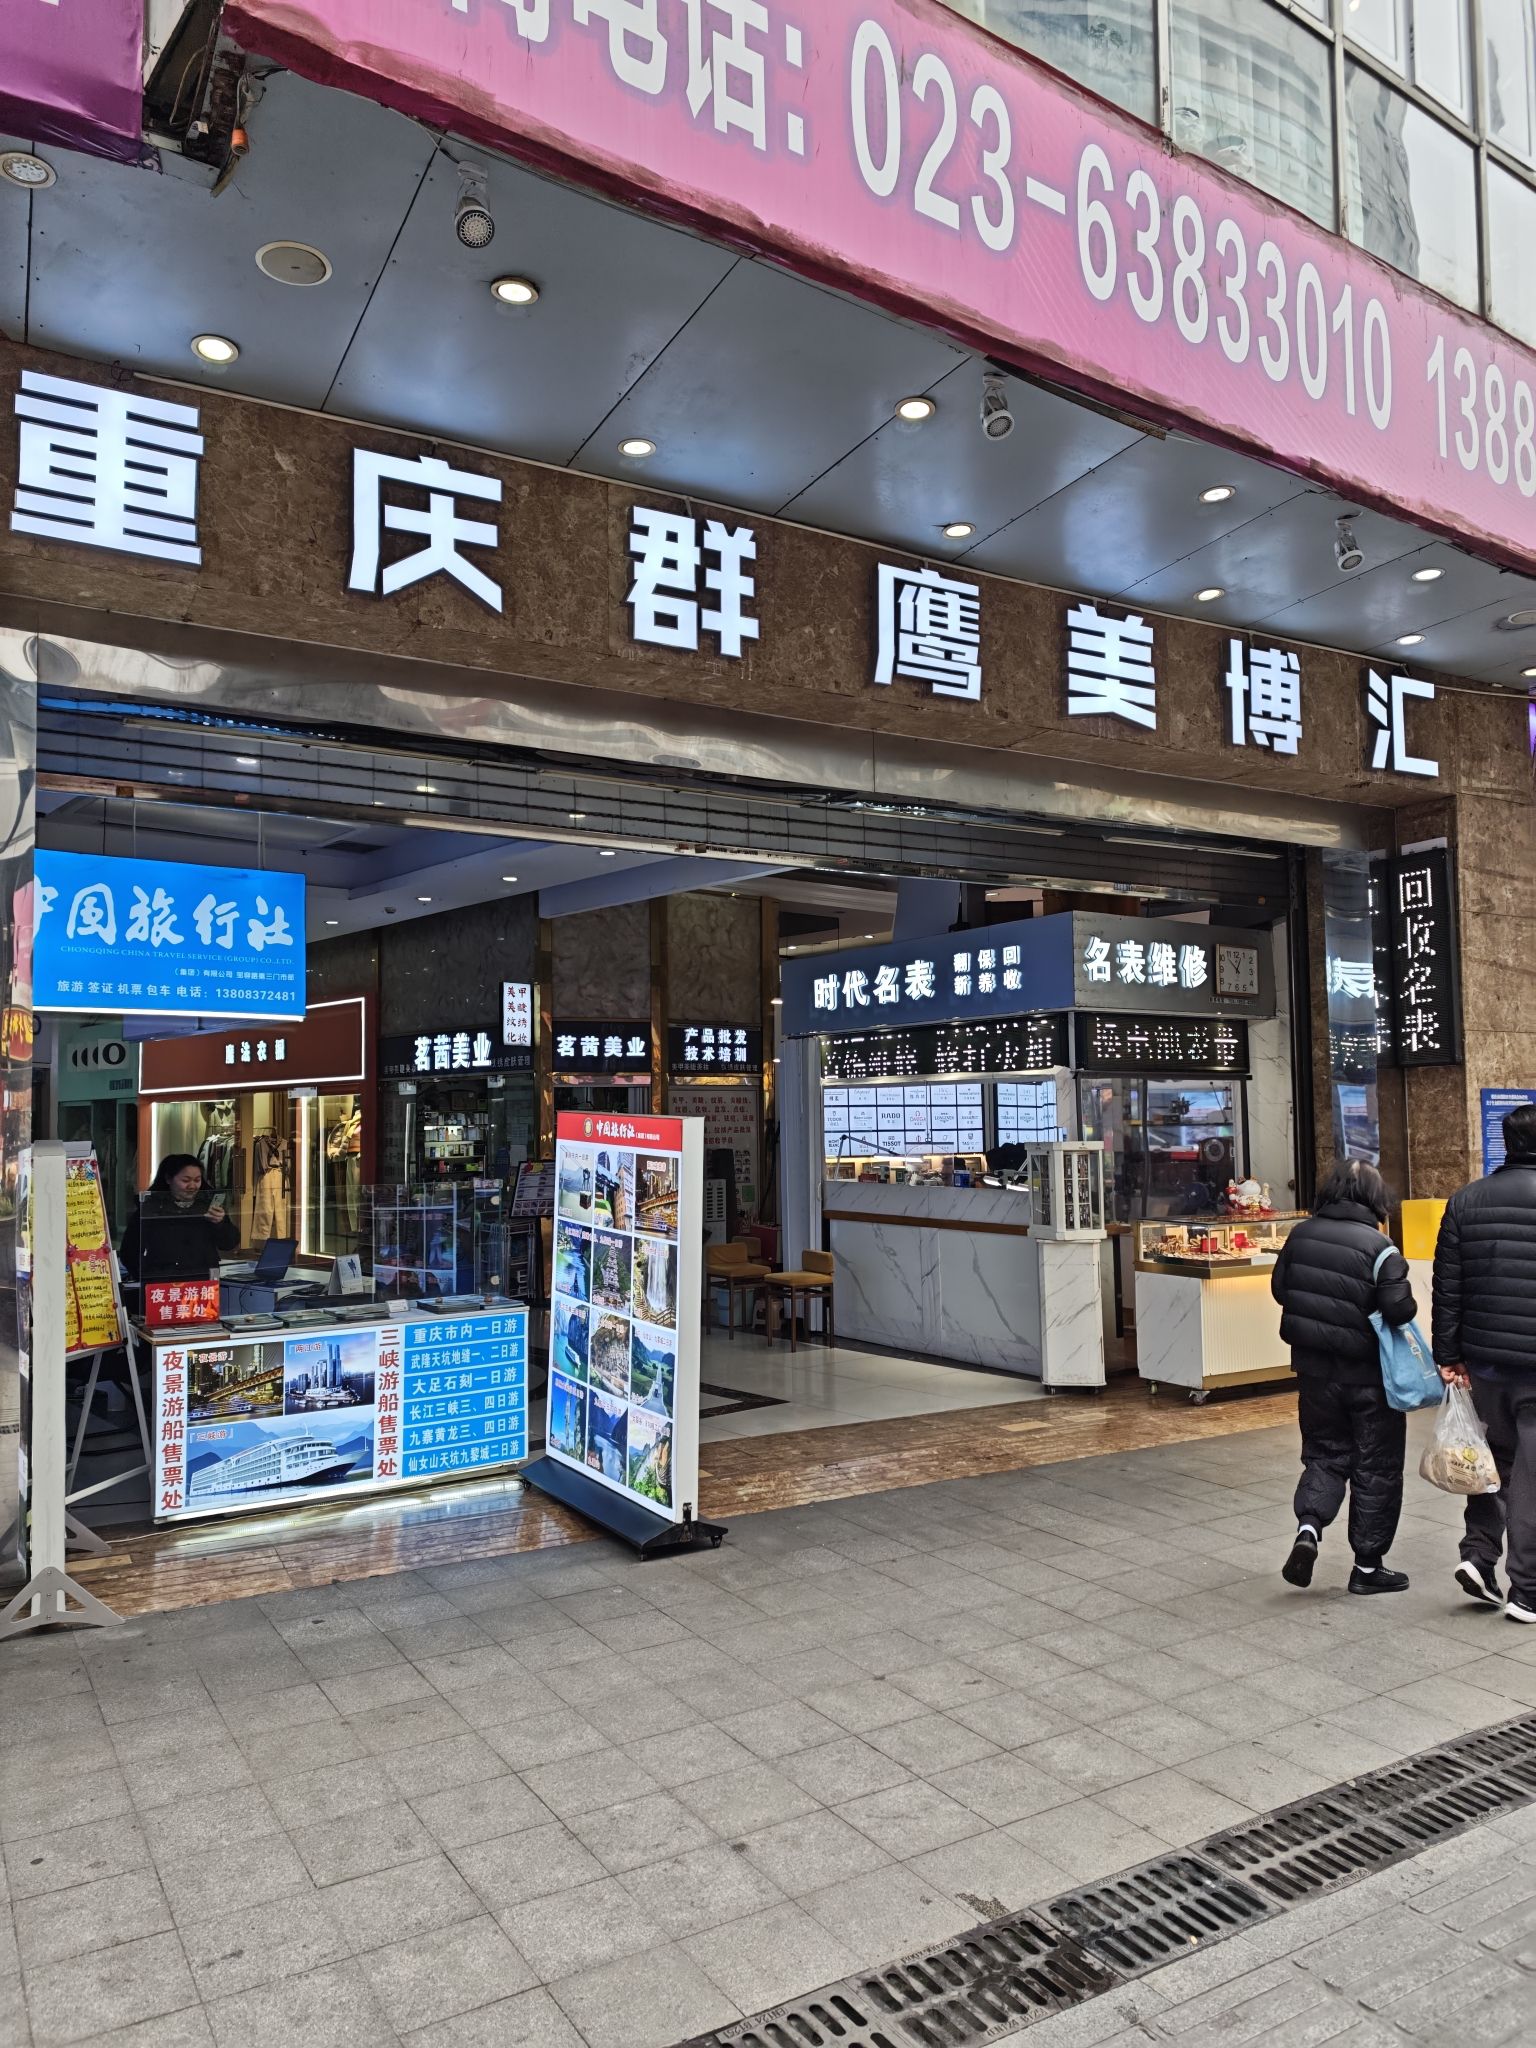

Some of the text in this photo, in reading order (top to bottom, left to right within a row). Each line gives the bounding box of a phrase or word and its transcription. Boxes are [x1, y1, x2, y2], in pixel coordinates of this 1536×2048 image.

[850, 19, 1393, 431] 023-63833010
[9, 369, 1440, 778] 重庆群鹰美博汇
[60, 945, 120, 956] CHONGQING
[120, 949, 150, 957] CHINA
[152, 951, 186, 959] TRAVEL
[187, 953, 222, 961] SERVICE
[1083, 936, 1209, 989] 名表维修
[1396, 867, 1441, 1053] 回收名表
[57, 980, 84, 993] 旅游
[88, 981, 113, 994] 签证
[117, 983, 143, 995] 机票
[146, 984, 171, 996] 包车
[215, 988, 296, 1002] 13808372481
[813, 959, 936, 1011] 时代名表
[683, 1027, 748, 1045] 产品批发
[684, 1045, 748, 1063] 技术培训
[150, 1286, 216, 1304] 夜景游船
[158, 1304, 209, 1321] 售票处
[412, 1318, 518, 1344] 重庆市内一日游
[410, 1342, 519, 1370] 武隆天坑地缝一、二日游
[411, 1367, 518, 1396] 大足石刻一日游
[376, 1328, 401, 1479] 三峡游船售票处
[409, 1391, 519, 1421] 长江三峡三、四日游
[160, 1350, 186, 1511] 夜景游船售票处
[409, 1415, 520, 1447] 九寨黄龙三、四日游
[407, 1439, 520, 1473] 仙女山天坑九黎城二日游
